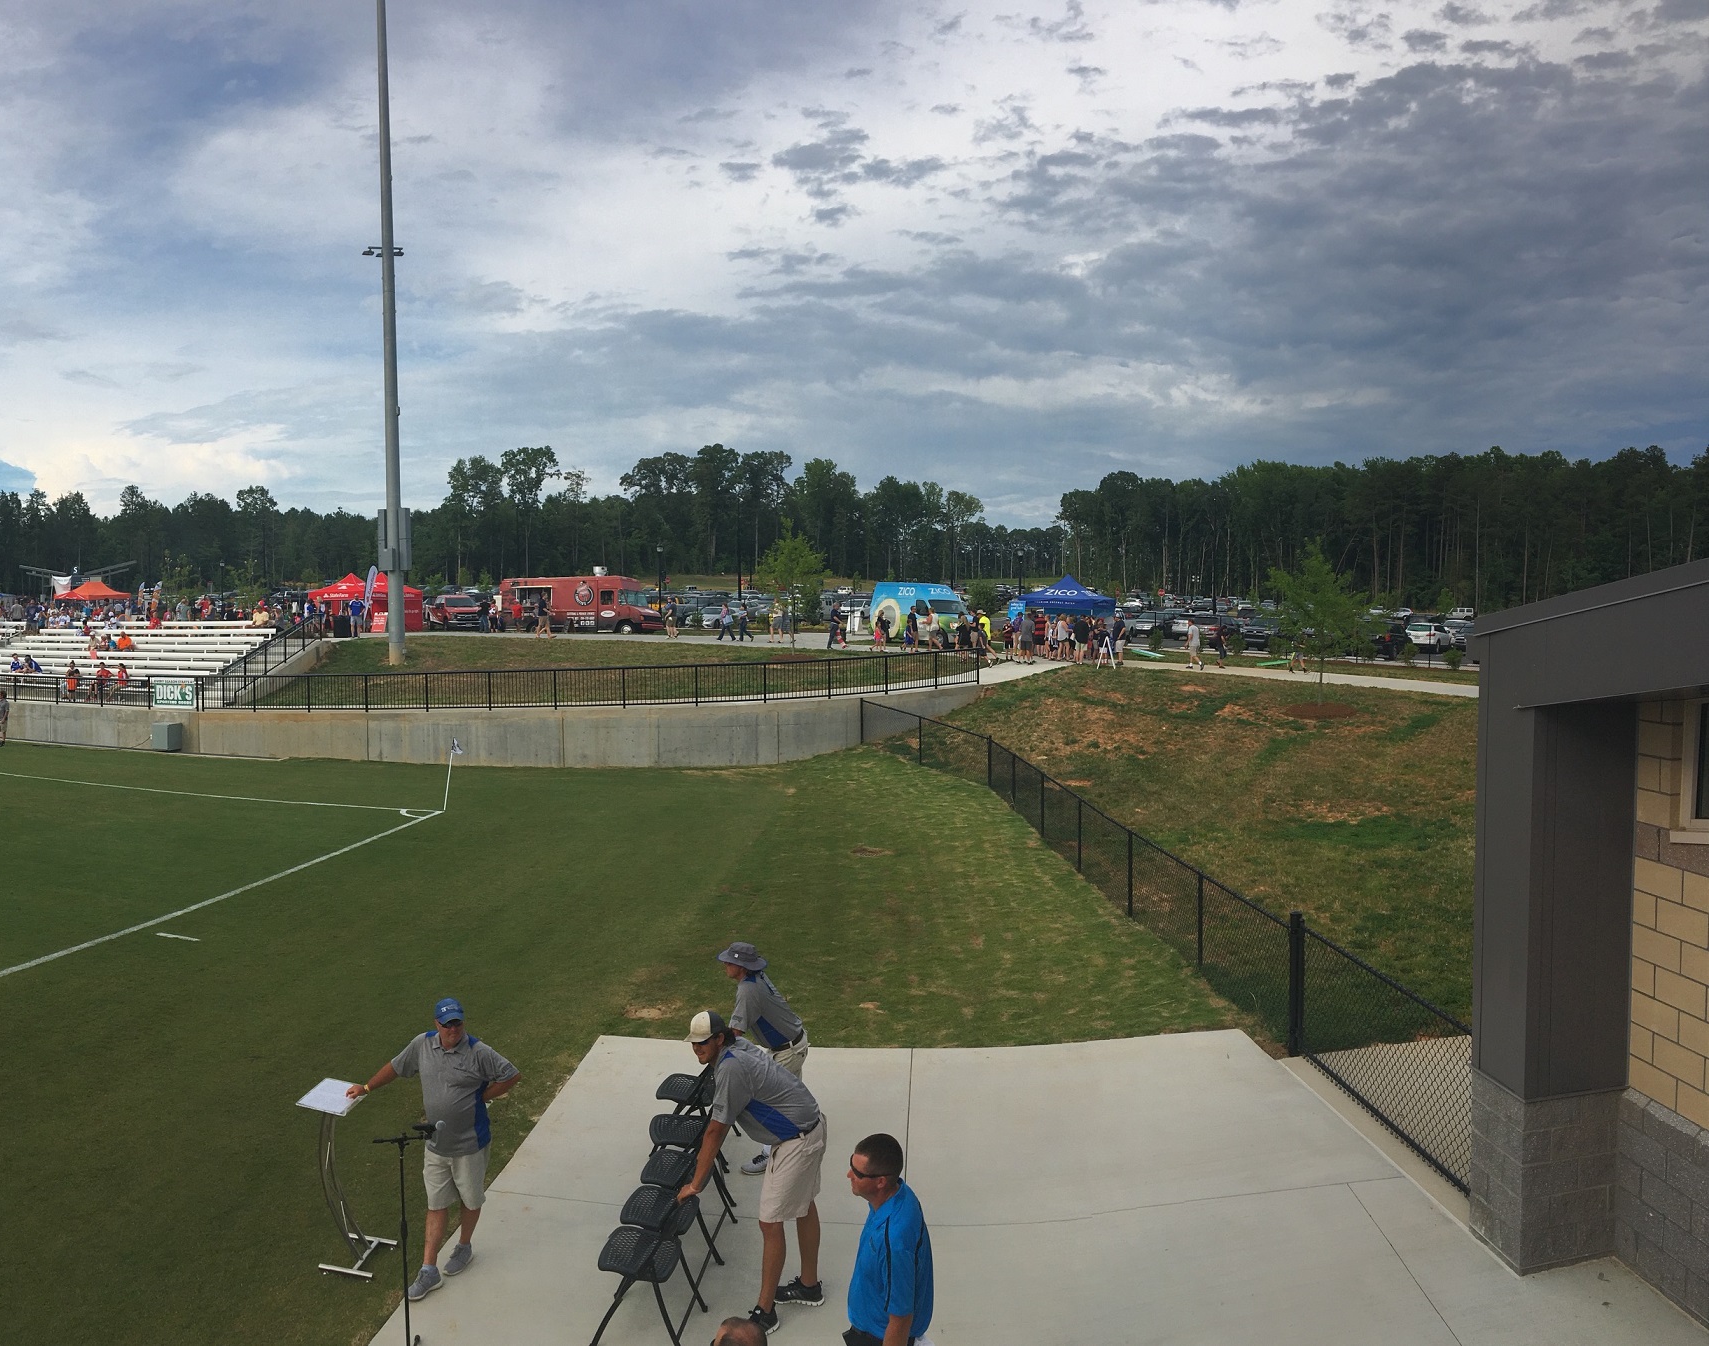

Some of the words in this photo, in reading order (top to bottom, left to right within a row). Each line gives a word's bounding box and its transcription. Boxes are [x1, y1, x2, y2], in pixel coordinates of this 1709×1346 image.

[898, 587, 916, 596] ZICO
[928, 587, 951, 595] ZICO
[1044, 588, 1078, 597] ZICO
